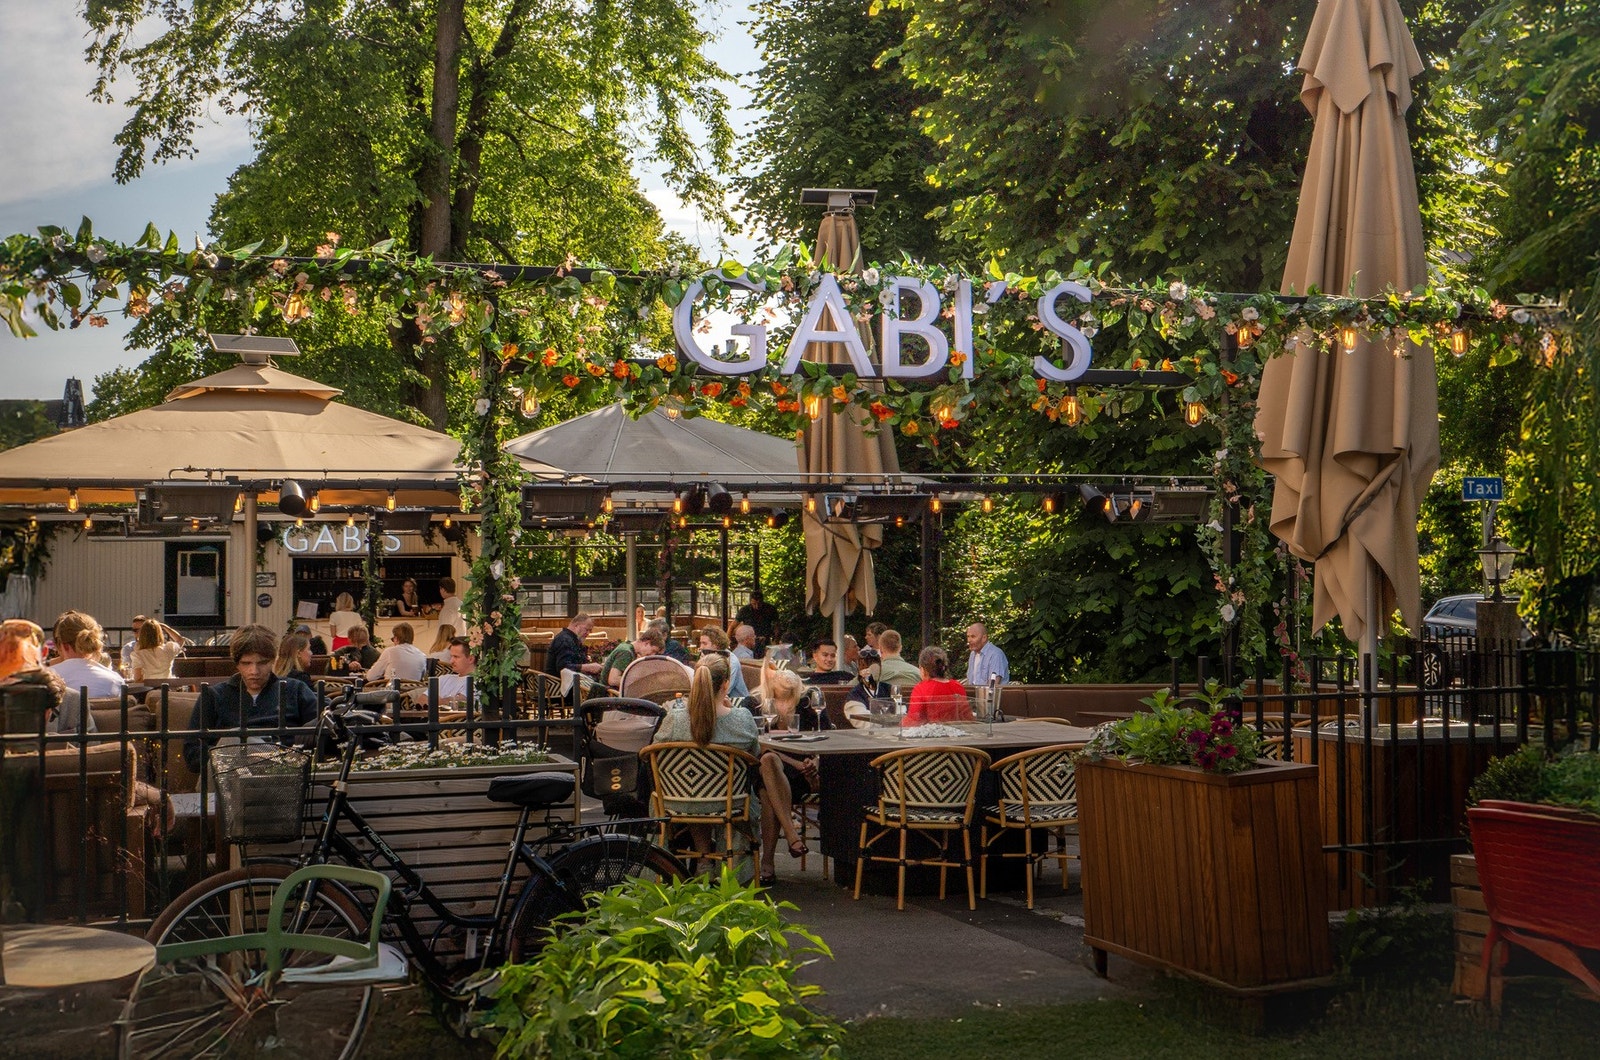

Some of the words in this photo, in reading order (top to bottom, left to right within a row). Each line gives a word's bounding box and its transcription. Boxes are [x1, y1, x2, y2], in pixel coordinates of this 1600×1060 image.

[672, 268, 1093, 382] GABI'S
[1466, 480, 1499, 495] Taxi
[362, 825, 400, 863] MERIDA
